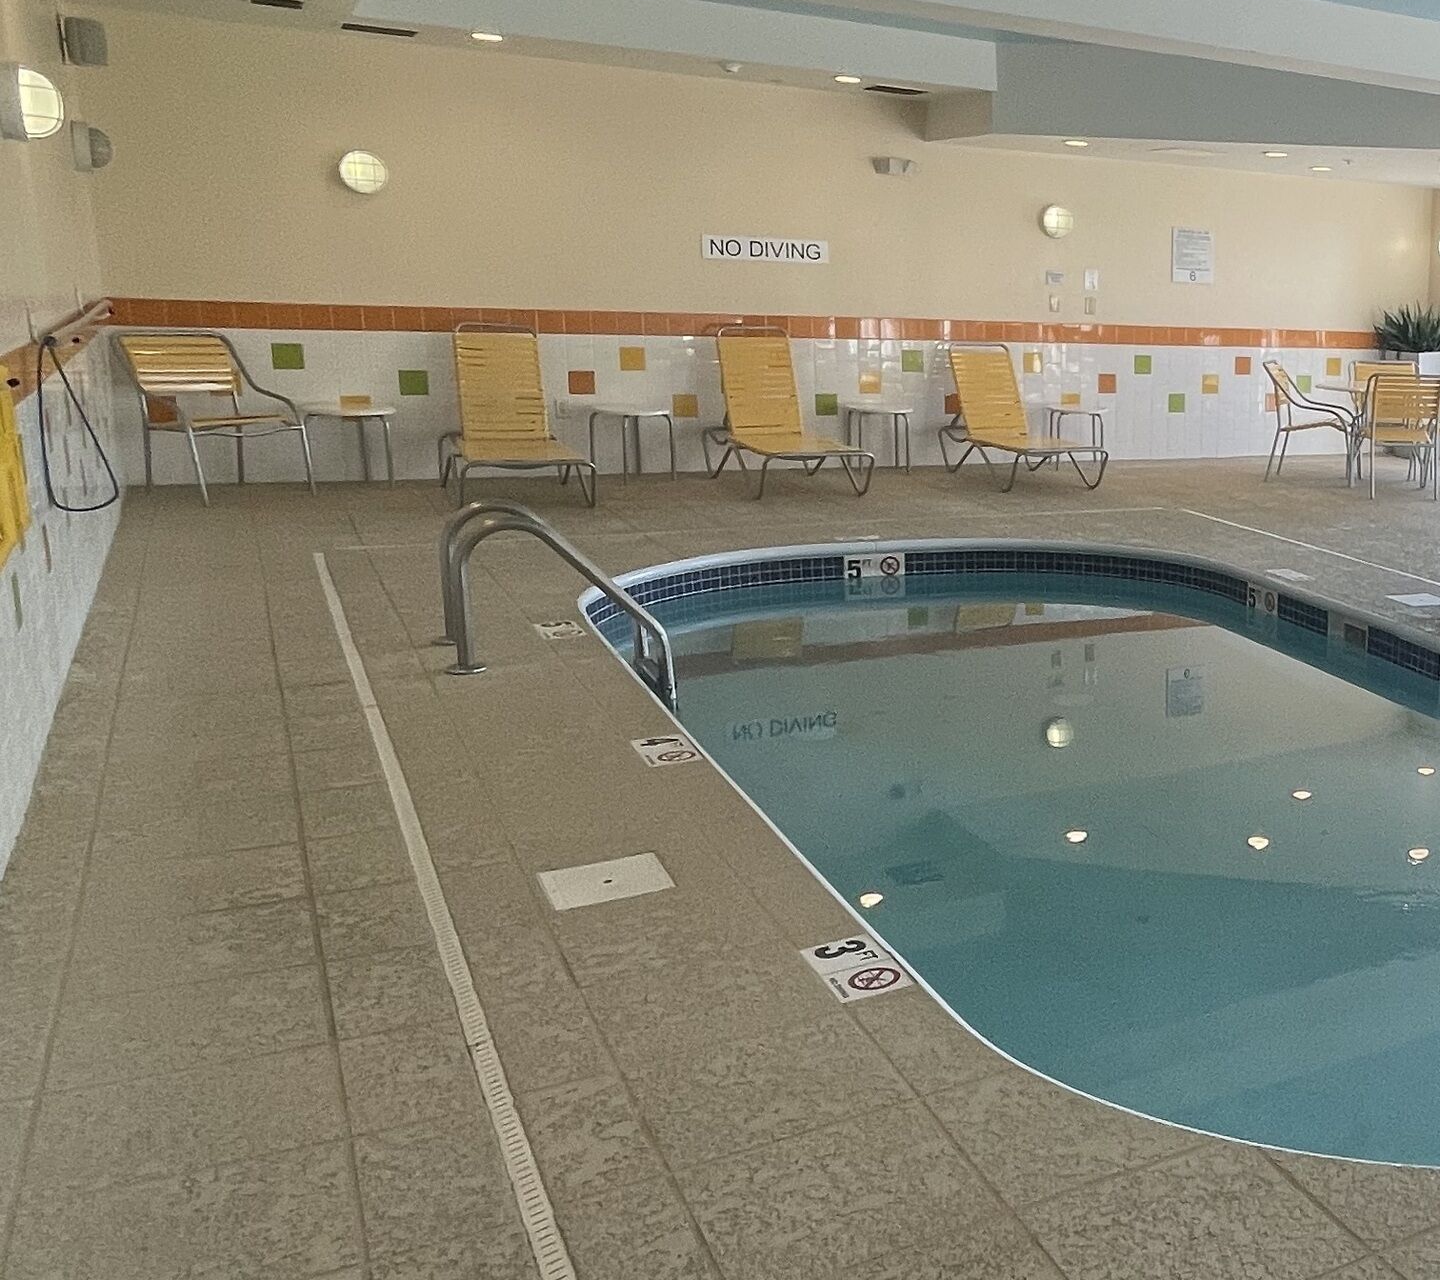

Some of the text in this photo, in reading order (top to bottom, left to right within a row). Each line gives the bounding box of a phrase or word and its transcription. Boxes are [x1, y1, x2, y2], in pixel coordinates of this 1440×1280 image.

[709, 239, 821, 260] NO DIVING
[847, 559, 862, 578] 5
[1249, 587, 1256, 608] 5
[640, 738, 679, 747] 4
[814, 939, 879, 962] 3 FT
